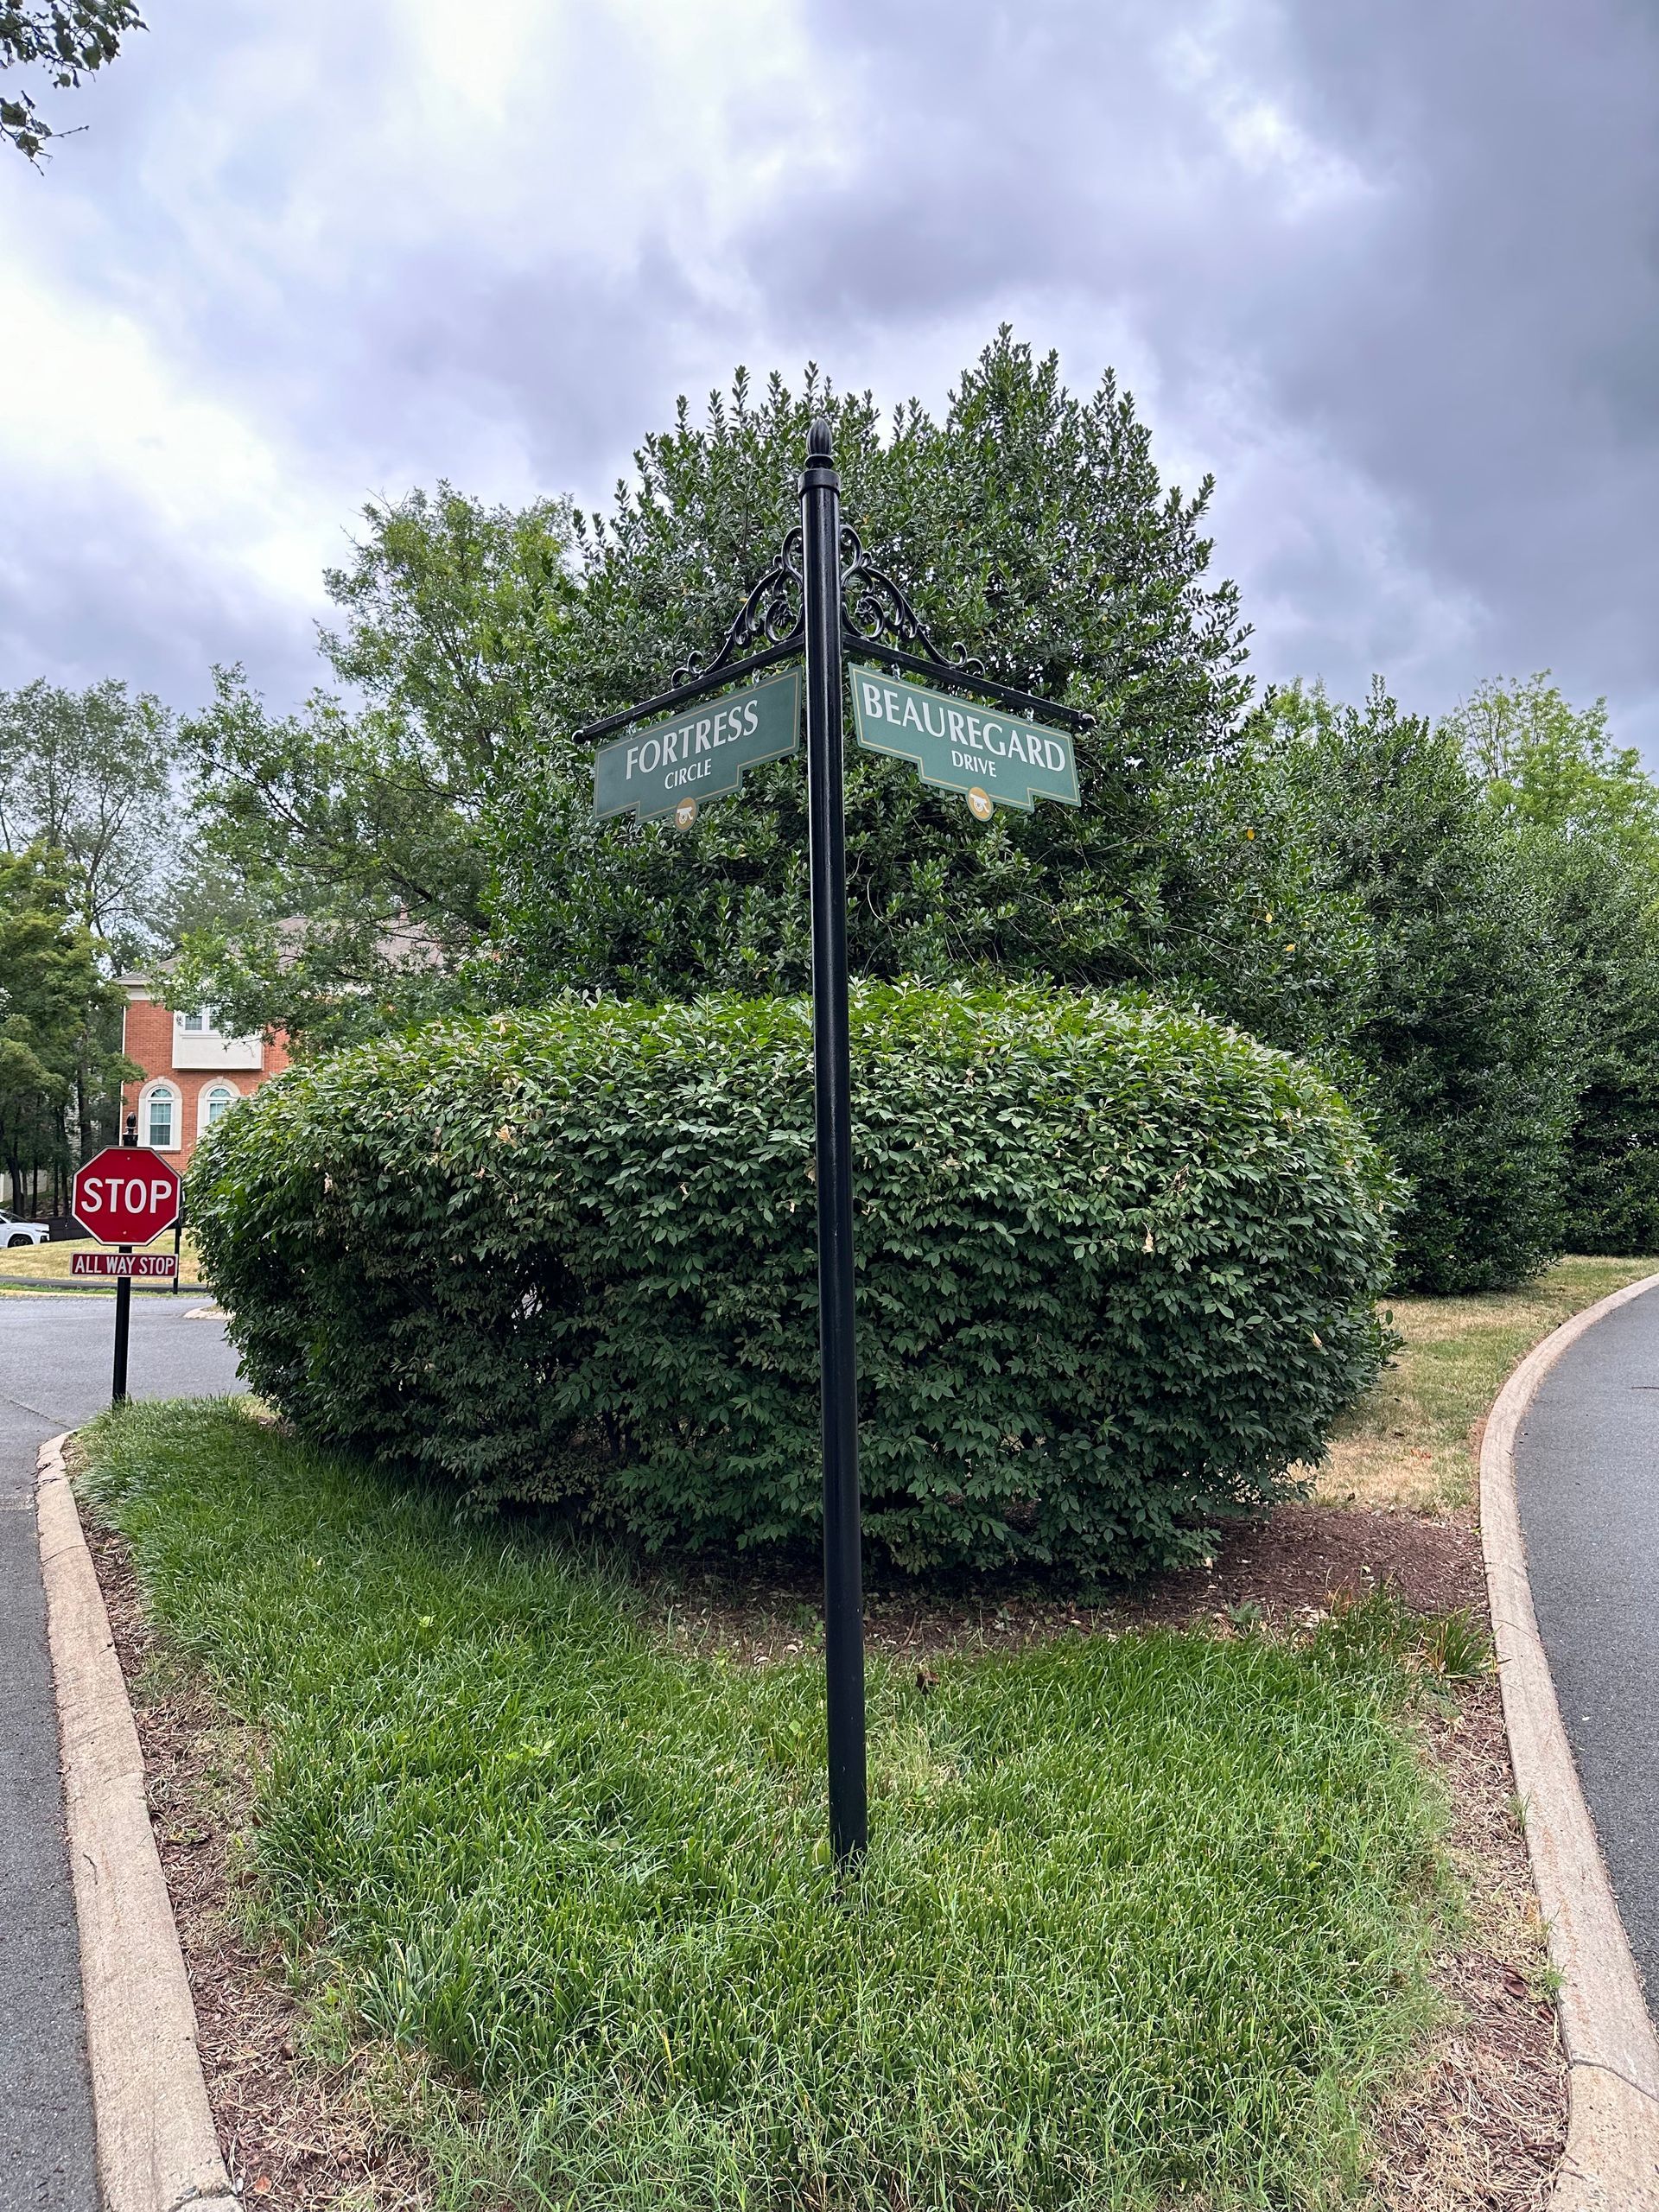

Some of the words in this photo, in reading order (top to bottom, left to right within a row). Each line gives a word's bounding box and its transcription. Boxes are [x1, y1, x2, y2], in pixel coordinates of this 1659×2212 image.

[626, 699, 759, 780] FORTRESS
[862, 683, 1065, 772] BEAUREGARD
[664, 758, 712, 790] CIRCLE
[951, 750, 997, 778] DRIVE
[80, 1177, 172, 1214] STOP
[74, 1255, 102, 1273] ALL
[106, 1256, 136, 1274] WAY
[138, 1256, 174, 1274] STOP
